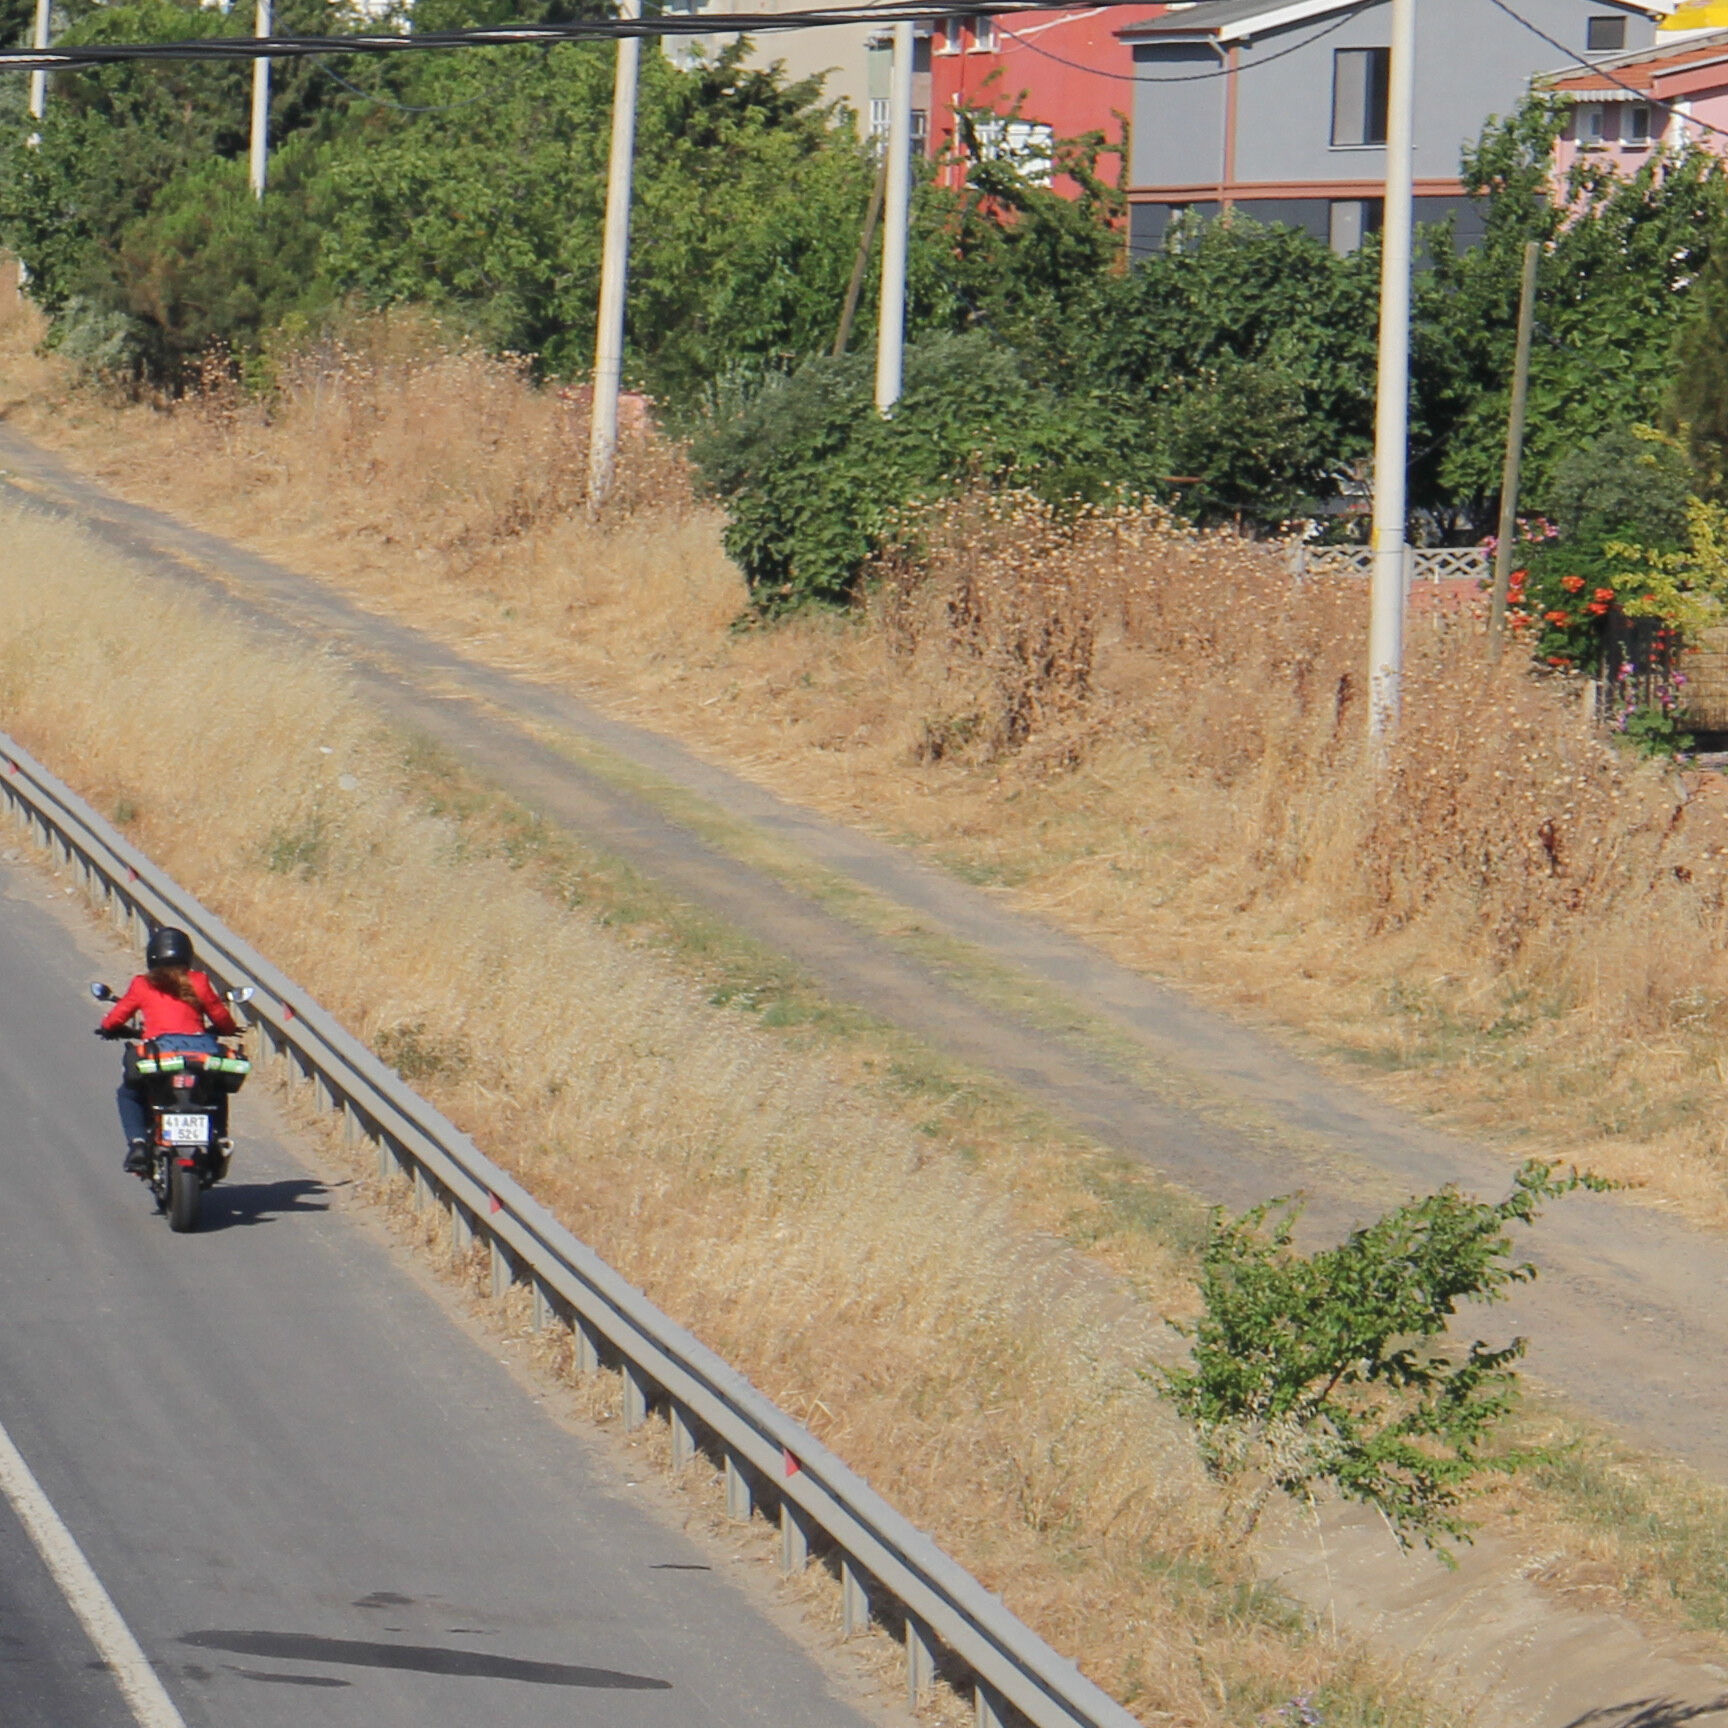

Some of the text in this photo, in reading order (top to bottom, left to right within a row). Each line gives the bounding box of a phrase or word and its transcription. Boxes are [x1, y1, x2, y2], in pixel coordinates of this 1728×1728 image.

[166, 1116, 206, 1127] 41 ART
[178, 1128, 200, 1140] 524
